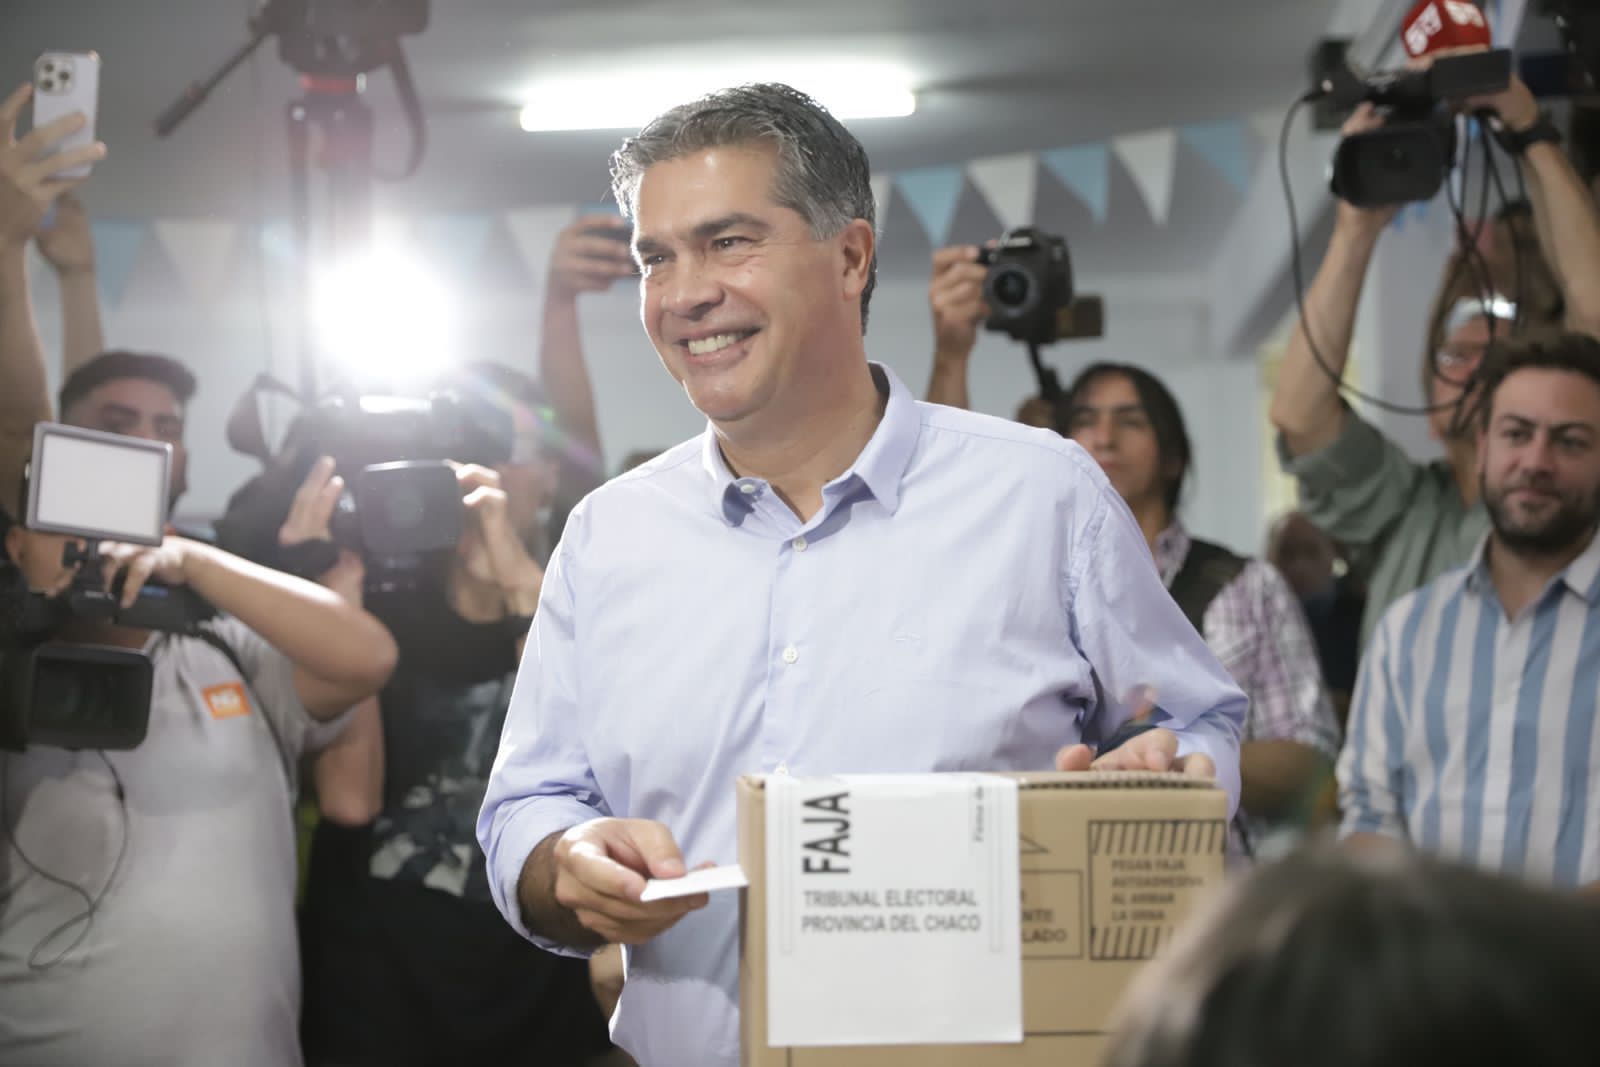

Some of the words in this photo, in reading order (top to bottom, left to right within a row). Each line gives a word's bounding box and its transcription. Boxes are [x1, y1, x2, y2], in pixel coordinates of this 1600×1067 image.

[803, 793, 850, 873] FAJA
[803, 889, 881, 907] TRIBUNAL
[885, 888, 978, 906] ELECTORAL
[802, 915, 886, 932] PROVINCIA
[890, 914, 920, 932] DEL
[924, 914, 981, 932] CHACO
